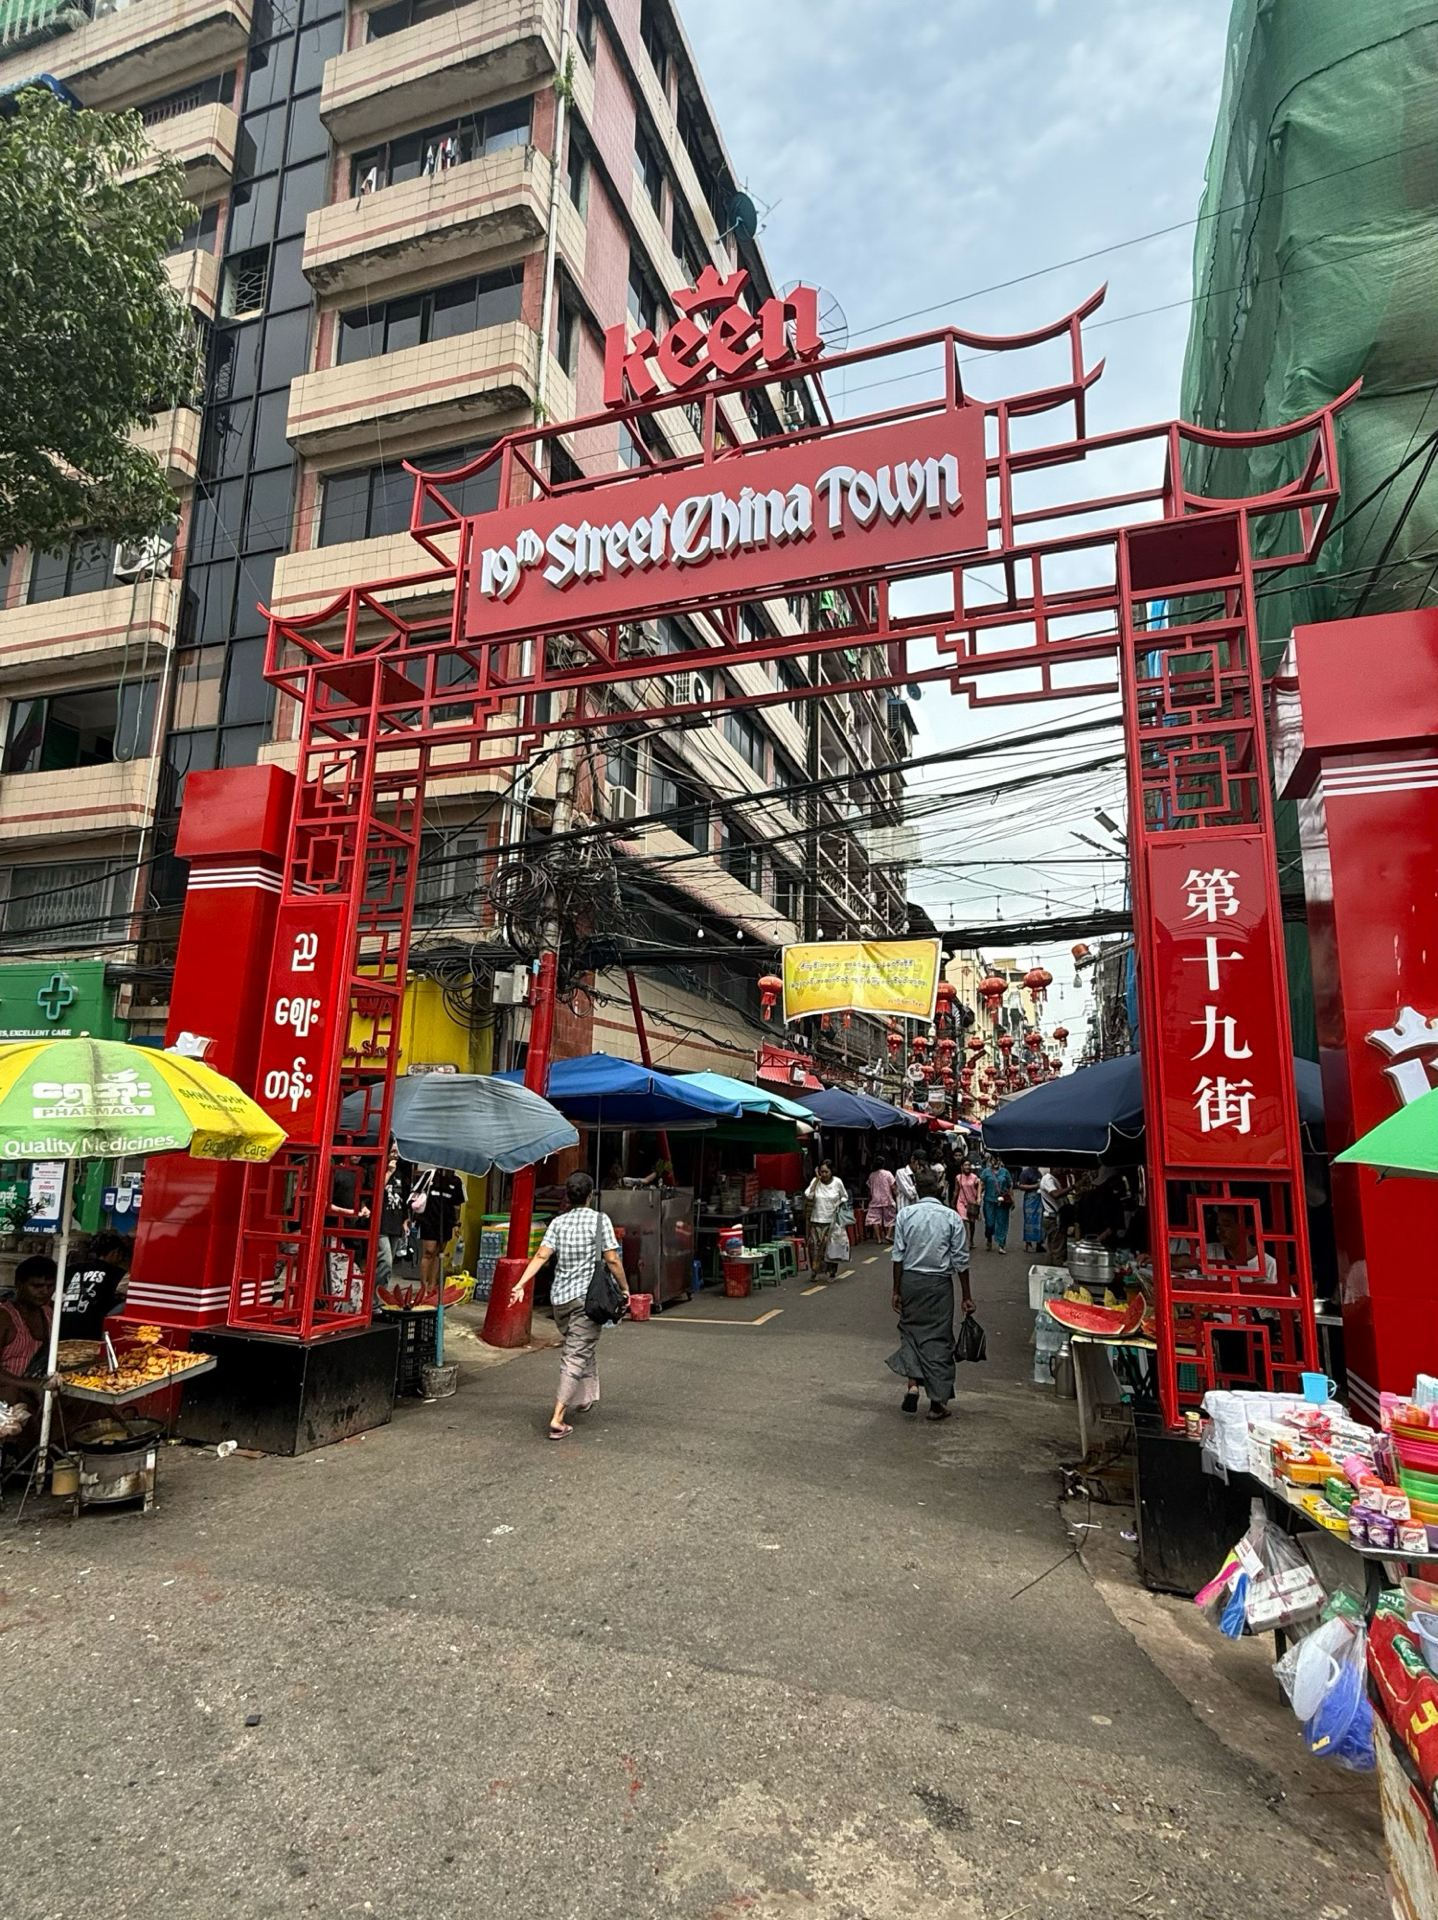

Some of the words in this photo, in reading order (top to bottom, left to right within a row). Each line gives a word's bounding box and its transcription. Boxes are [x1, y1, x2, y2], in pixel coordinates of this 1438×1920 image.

[602, 284, 824, 409] keen
[541, 502, 674, 592] Street
[668, 480, 816, 567] China
[1179, 867, 1256, 1135] 第十九街
[9, 1029, 49, 1037] EXCELLENT
[51, 1029, 72, 1037] CARE
[42, 1106, 146, 1117] PHARMACY
[4, 1137, 77, 1156] Quality
[243, 1140, 268, 1157] Care
